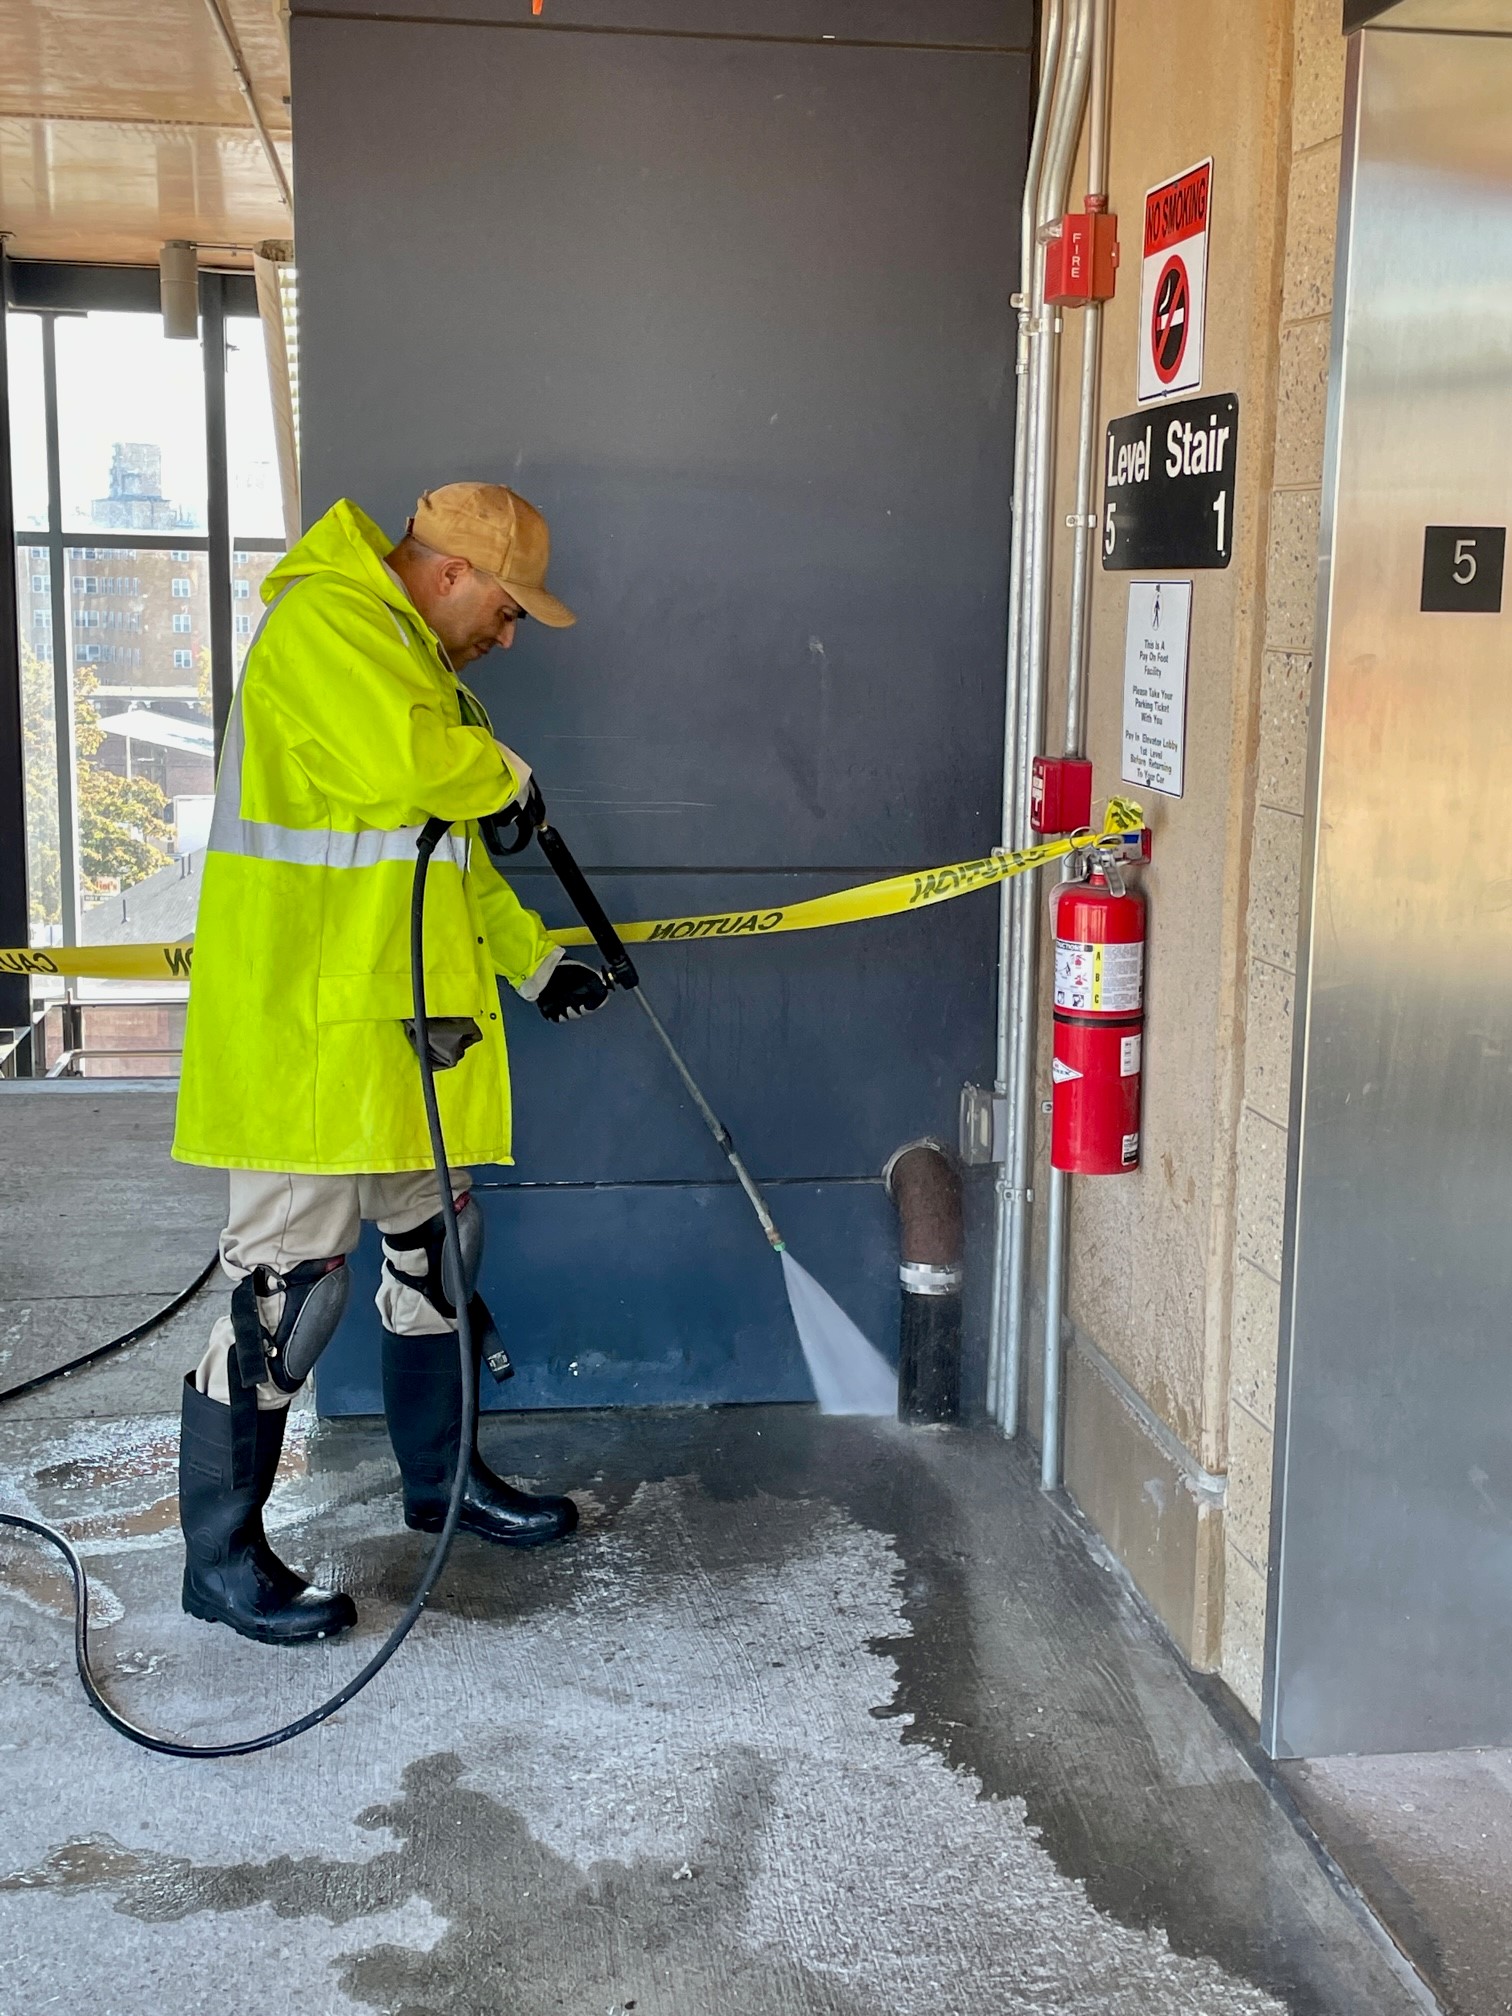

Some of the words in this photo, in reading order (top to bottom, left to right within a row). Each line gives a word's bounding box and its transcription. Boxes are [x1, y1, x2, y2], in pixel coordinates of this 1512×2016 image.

[1146, 201, 1160, 246] NO
[1162, 177, 1206, 238] SMOKING
[1071, 232, 1082, 278] FIRE
[1107, 425, 1152, 487] Level
[1165, 414, 1230, 478] Stair
[1105, 502, 1117, 555] 5
[1213, 490, 1226, 551] 1
[1452, 540, 1477, 585] 5
[1095, 951, 1101, 961] A
[1095, 973, 1100, 982] B
[1094, 994, 1099, 1004] C
